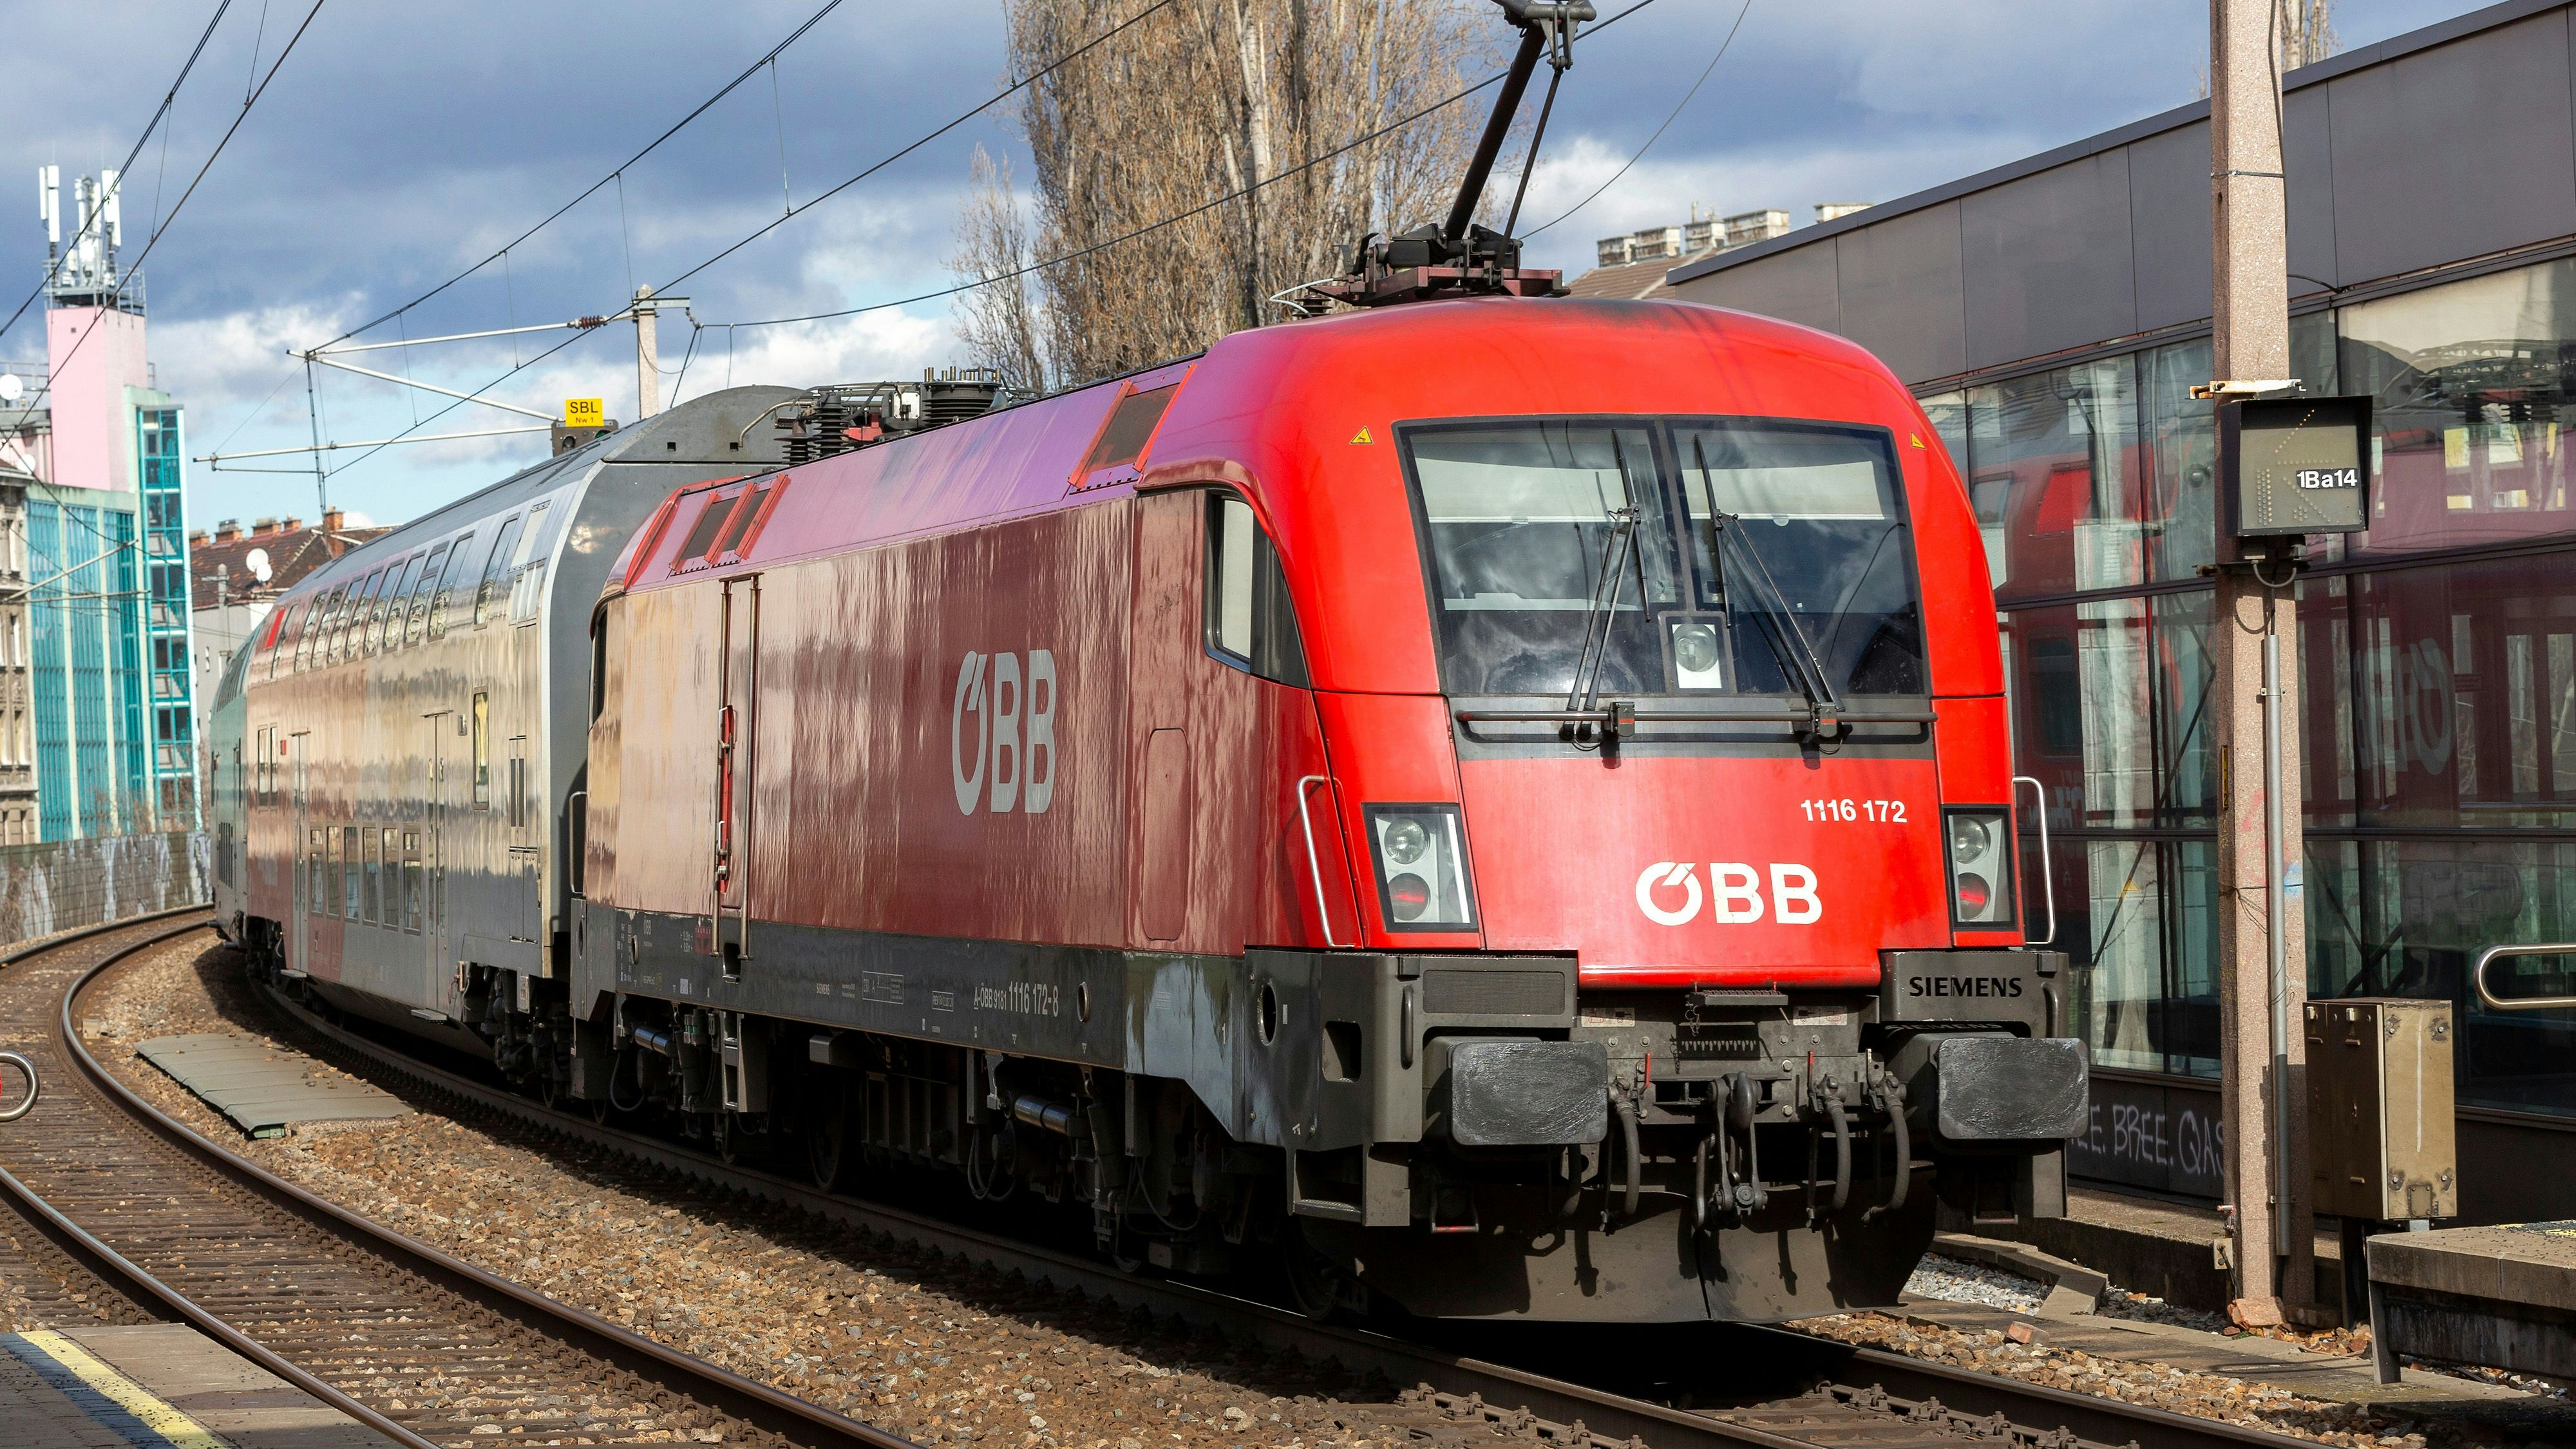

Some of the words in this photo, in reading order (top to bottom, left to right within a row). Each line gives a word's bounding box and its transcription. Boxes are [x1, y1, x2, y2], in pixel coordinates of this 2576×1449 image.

[570, 401, 598, 413] SBL
[2297, 469, 2357, 489] 1Ba14
[952, 649, 1057, 816] ÖBB
[1800, 799, 1856, 821] 1116
[1862, 800, 1907, 822] 172
[1635, 862, 1822, 926] ÖBB
[816, 983, 830, 995] SIEMENS
[1909, 976, 2022, 998] SIEMENS
[1009, 981, 1030, 1014] 1116
[1033, 983, 1058, 1017] 172-8
